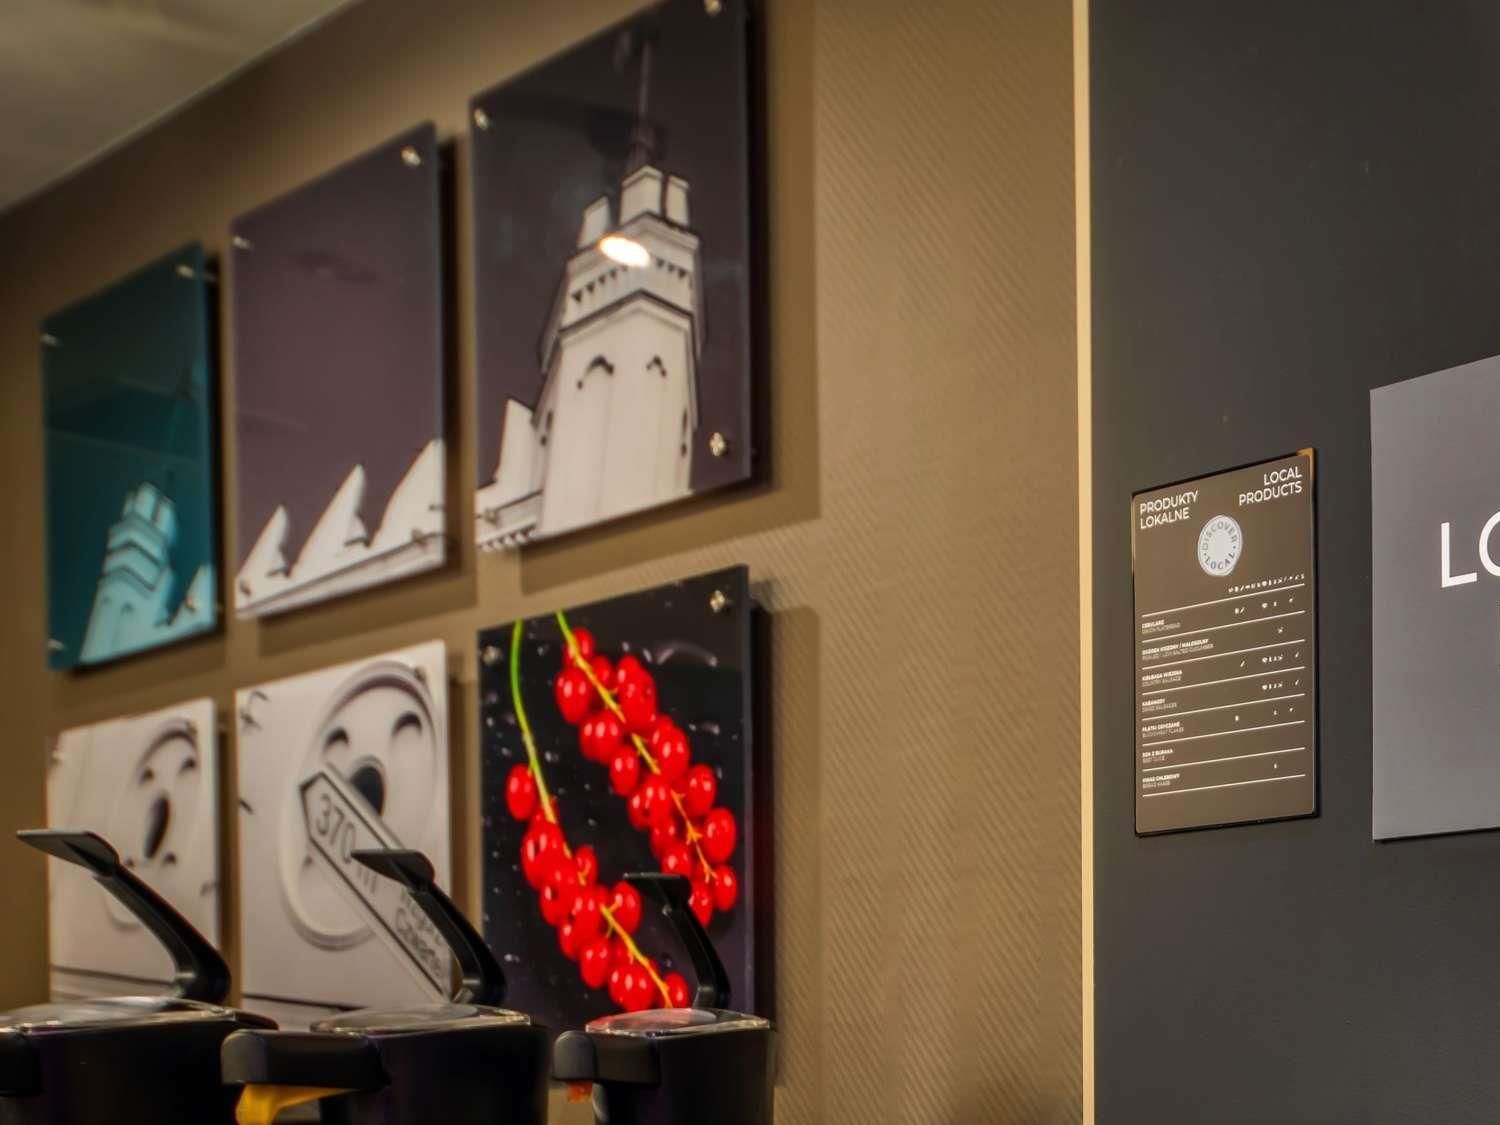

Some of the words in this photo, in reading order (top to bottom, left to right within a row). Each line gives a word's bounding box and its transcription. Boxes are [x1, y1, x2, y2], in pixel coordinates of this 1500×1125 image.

[1263, 466, 1303, 486] LOCAL
[1139, 490, 1199, 515] PRODUKTY
[1238, 481, 1303, 507] PRODUCTS
[1140, 507, 1190, 530] LOKALNE
[1201, 520, 1239, 551] DISCOVER
[1203, 551, 1237, 571] LOCAL
[315, 793, 357, 866] 370
